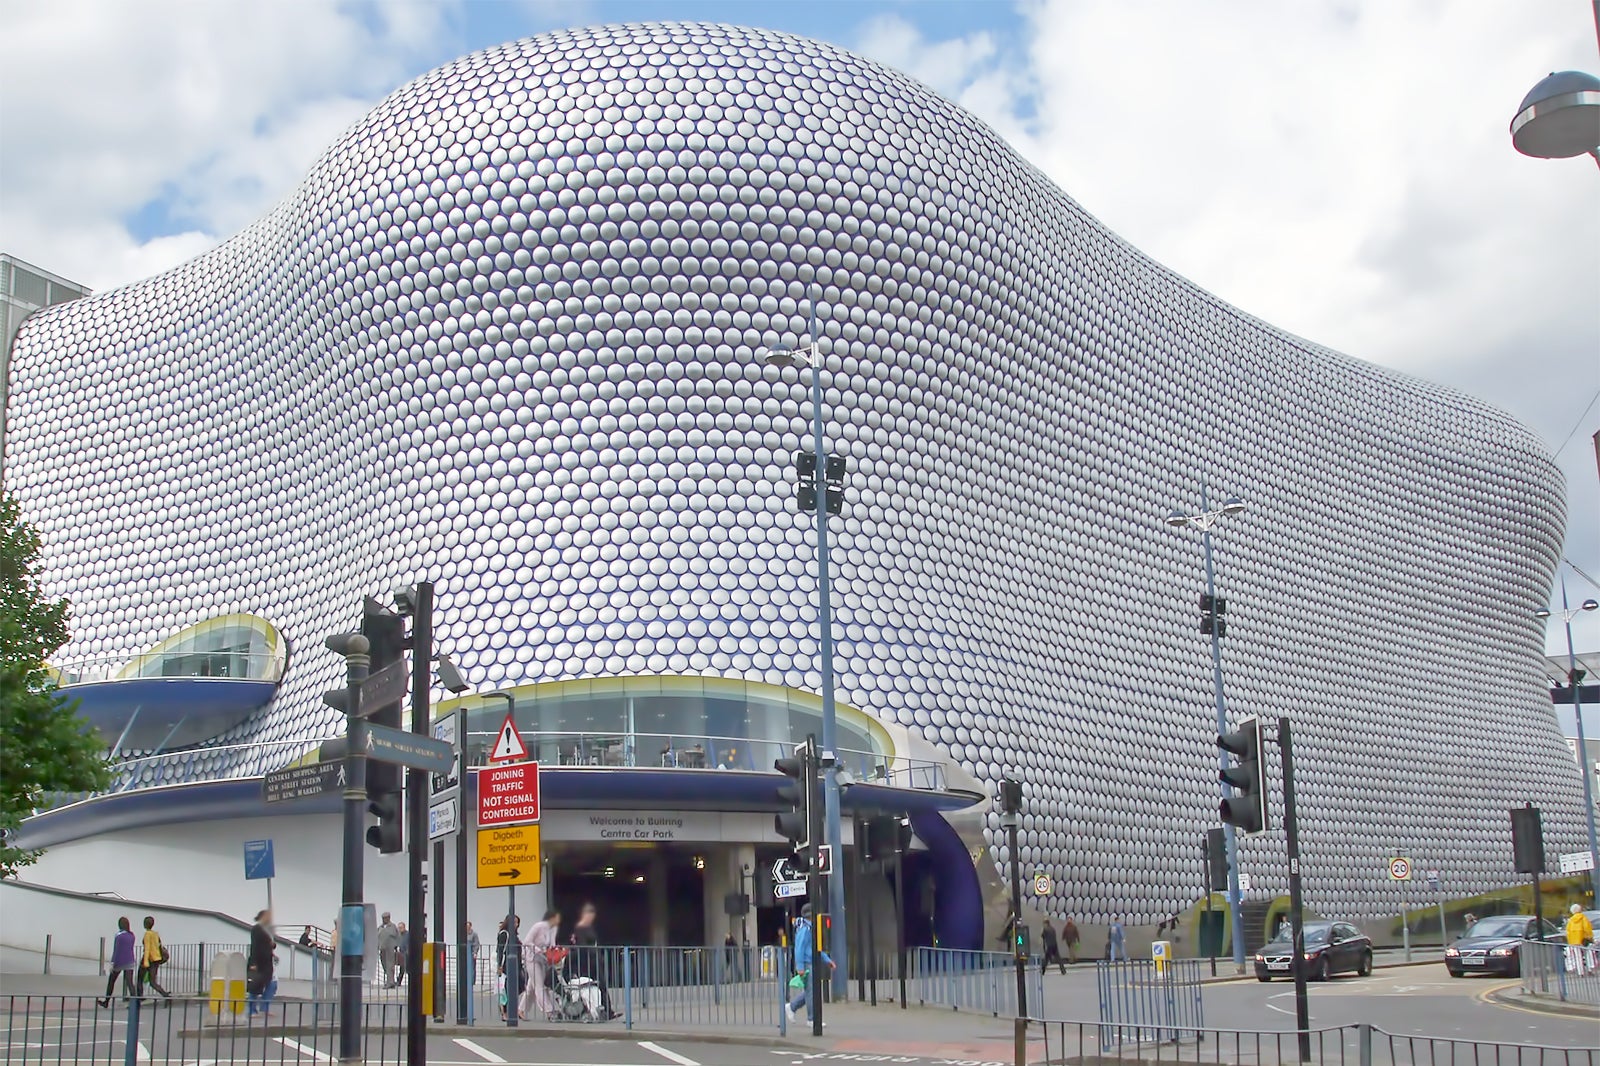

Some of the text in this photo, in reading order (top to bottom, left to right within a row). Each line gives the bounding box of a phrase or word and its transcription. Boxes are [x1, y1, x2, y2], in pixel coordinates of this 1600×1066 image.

[319, 763, 334, 774] AREA
[491, 768, 525, 781] JOINING
[492, 781, 524, 793] TRAFFIC
[483, 794, 534, 808] NOT SIGNAL
[482, 806, 535, 820] CONTROLLED
[589, 816, 633, 826] Welcome
[636, 817, 645, 826] to
[493, 829, 523, 842] Digbeth
[600, 829, 674, 838] Centre Car Park
[488, 842, 529, 854] Temporary
[481, 853, 537, 866] Coach Station
[1394, 864, 1407, 873] 20
[1037, 881, 1047, 889] 20
[931, 1058, 1016, 1066] OOK
